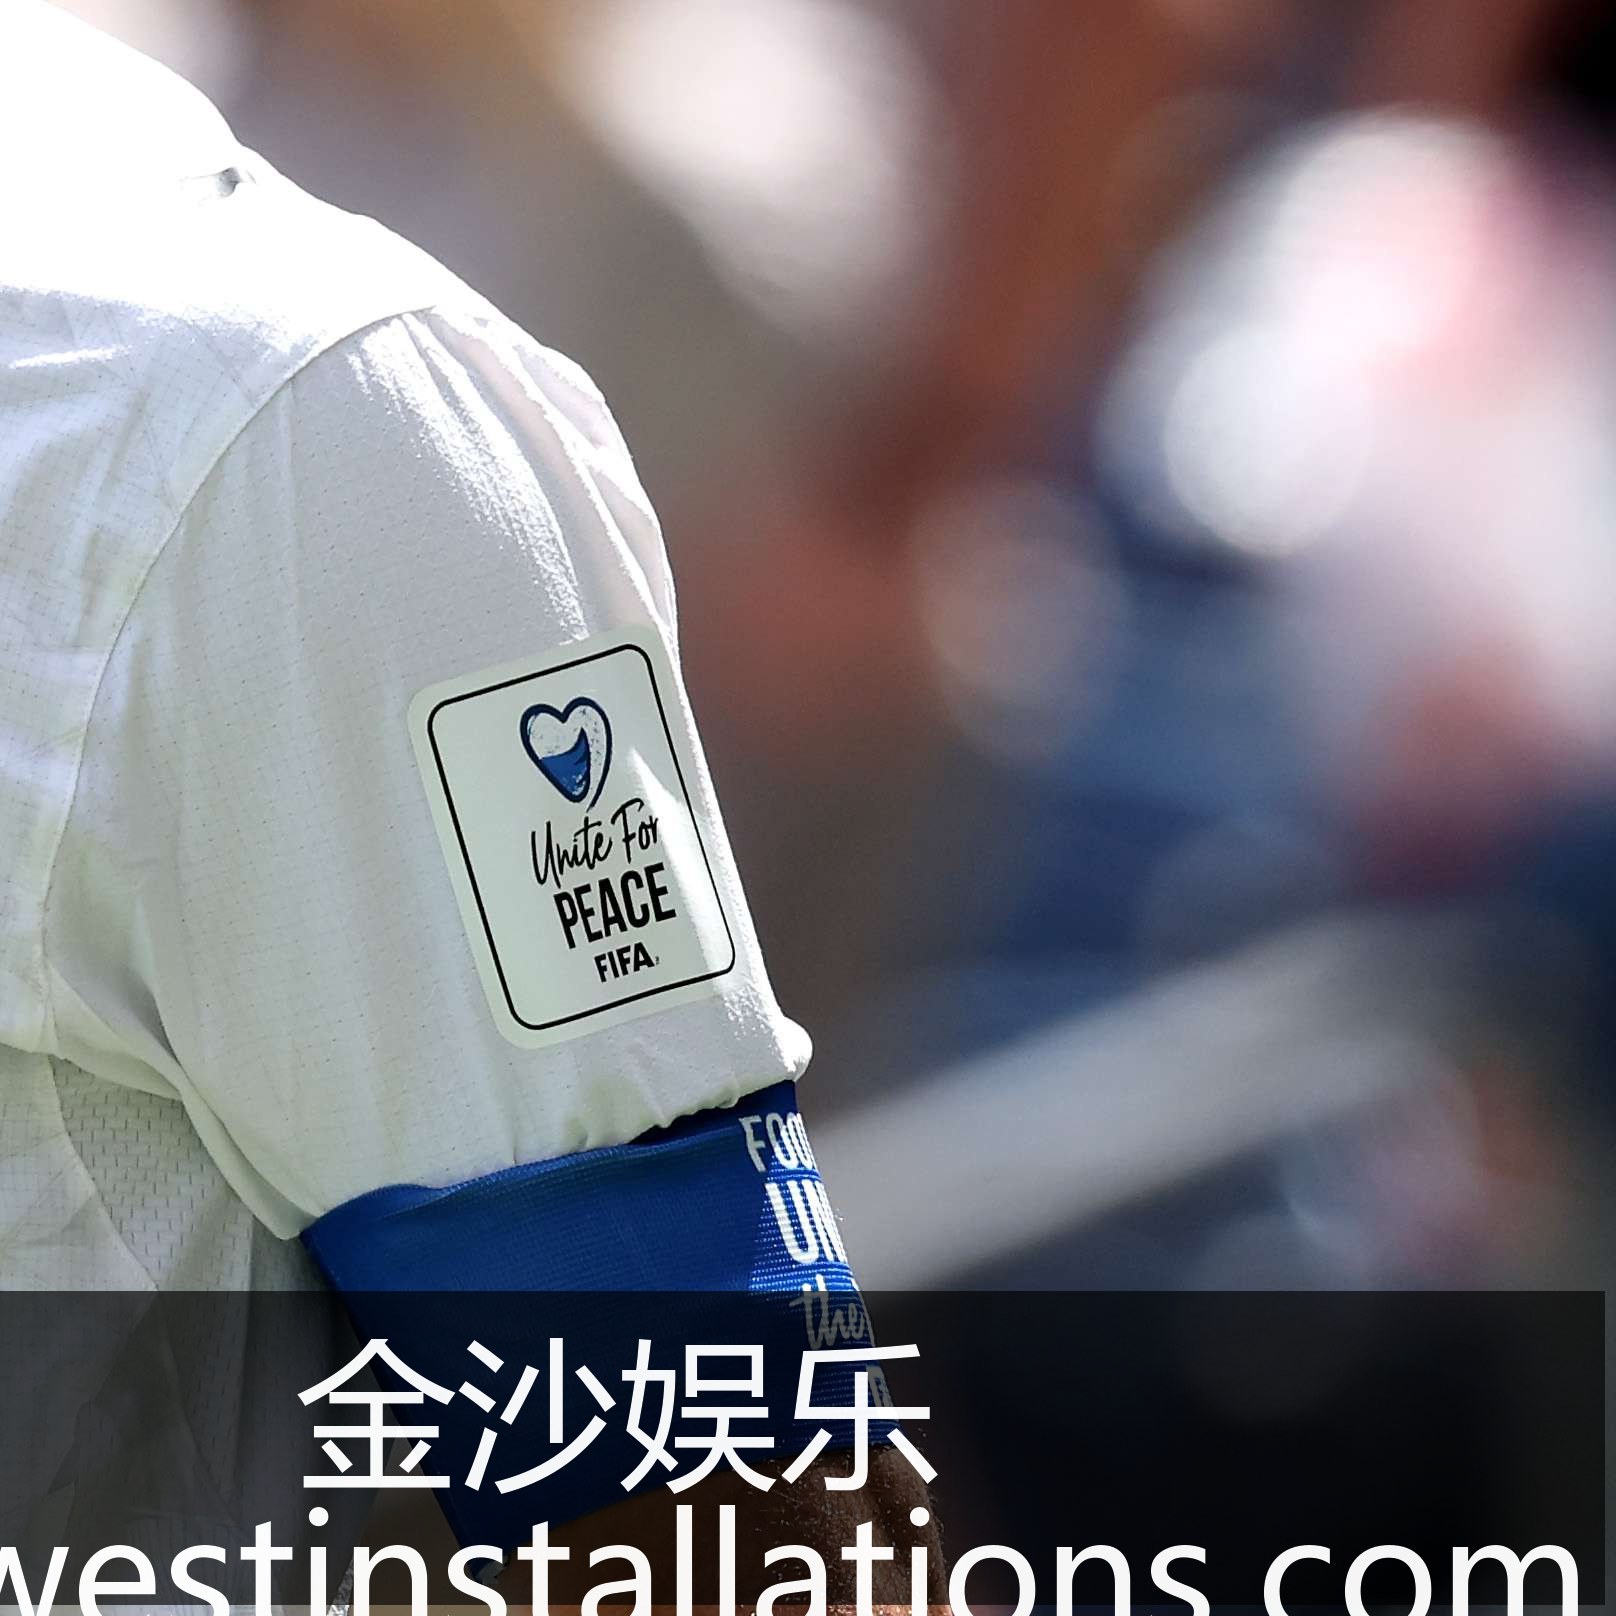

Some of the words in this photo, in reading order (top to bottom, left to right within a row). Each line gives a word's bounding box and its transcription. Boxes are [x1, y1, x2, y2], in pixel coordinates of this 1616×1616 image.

[531, 815, 613, 889] Unite
[610, 797, 659, 864] For
[553, 861, 677, 950] PEACE
[594, 942, 656, 983] FIFA
[739, 1112, 817, 1173] FOO
[764, 1179, 848, 1264] UN
